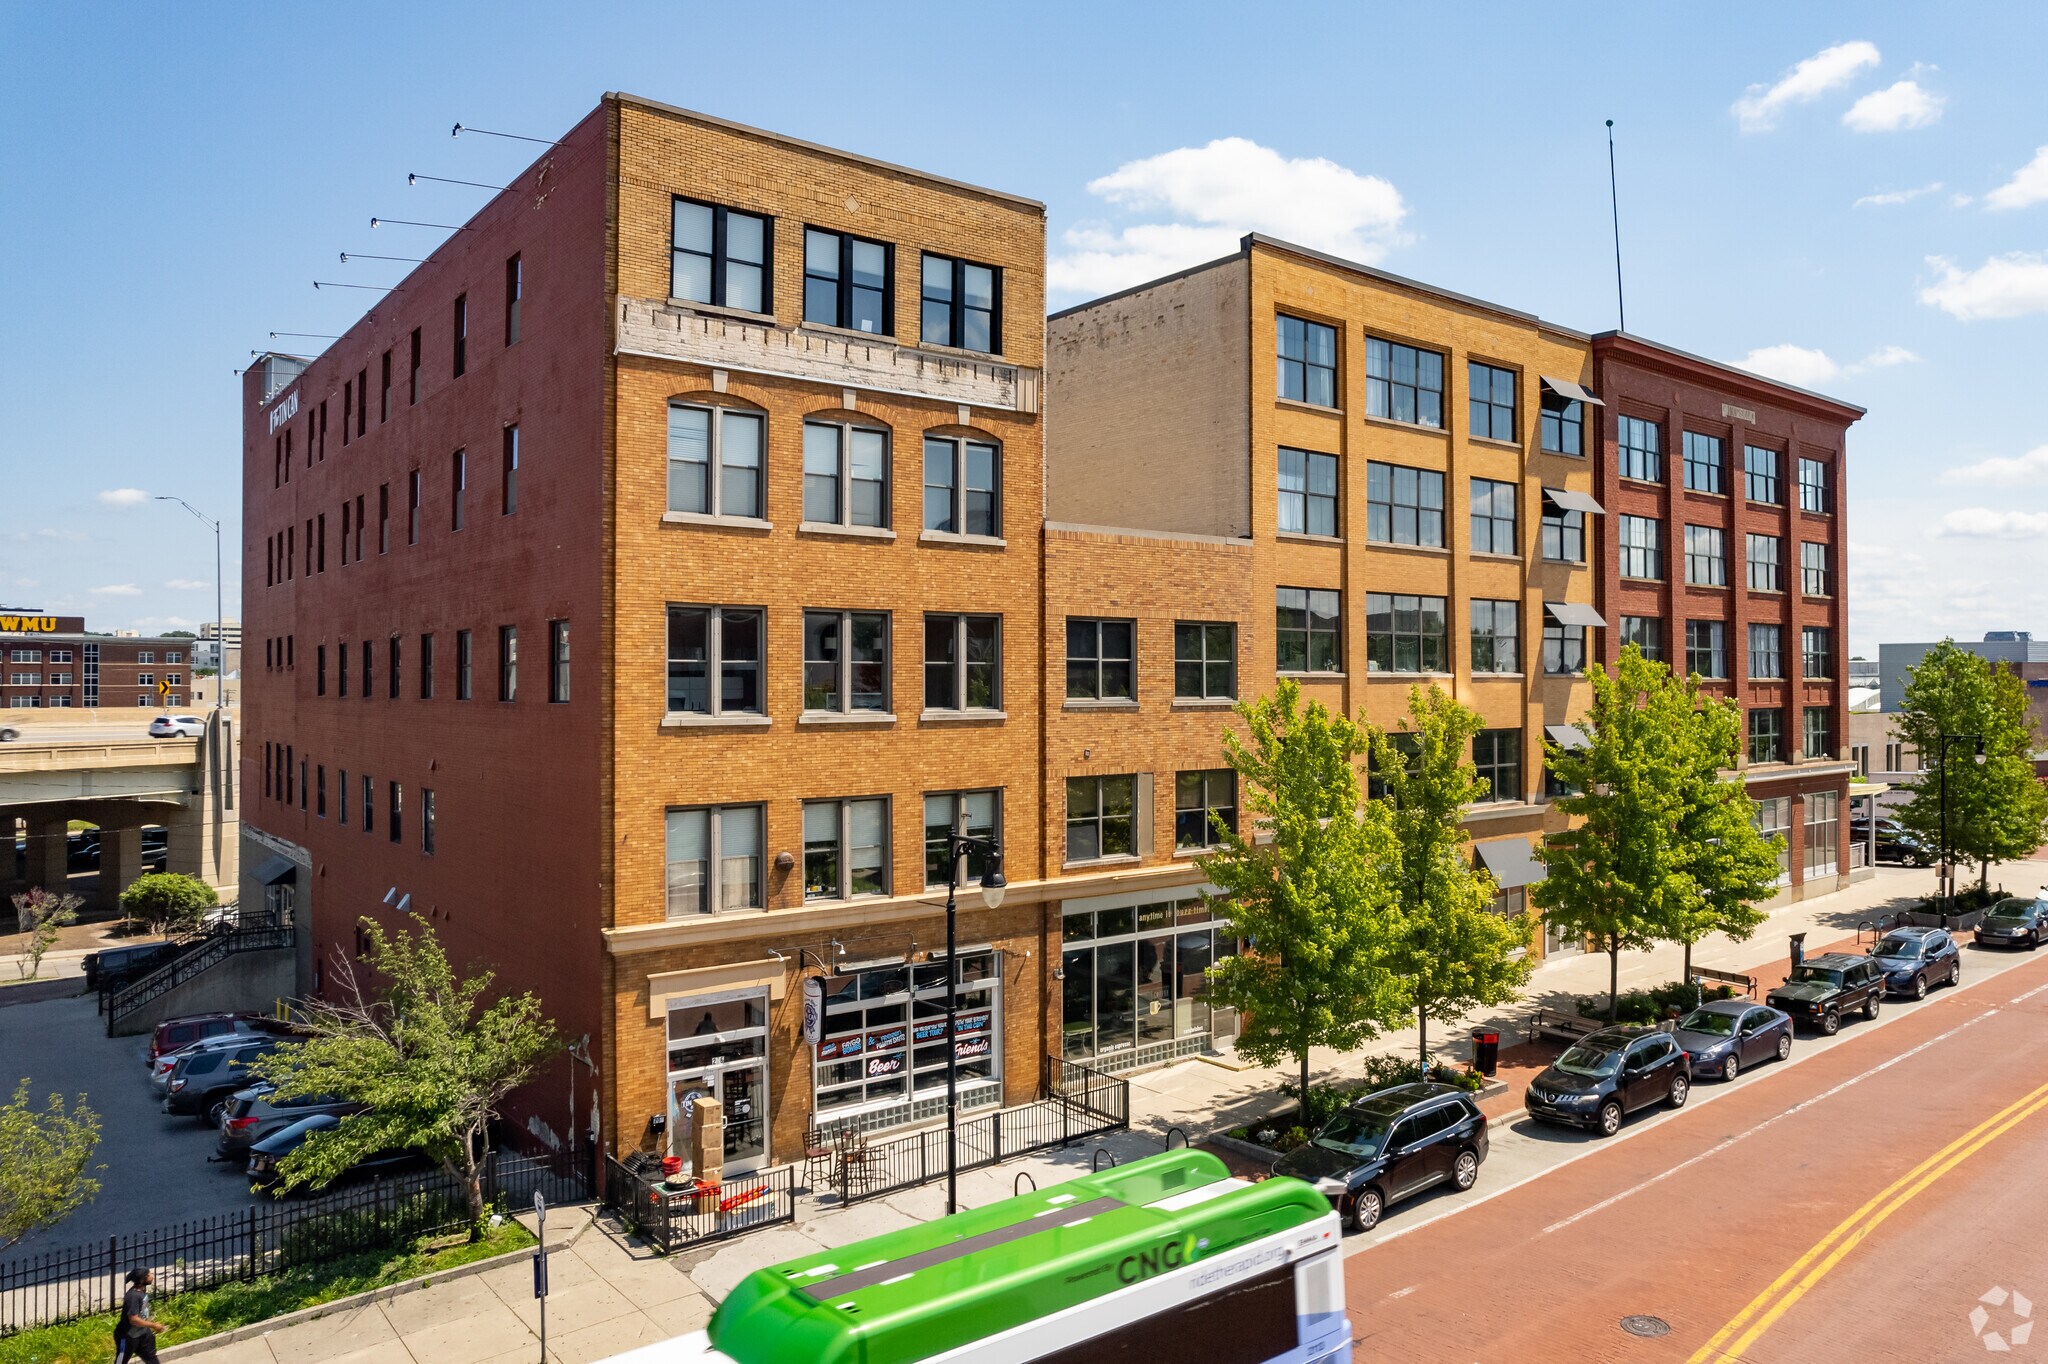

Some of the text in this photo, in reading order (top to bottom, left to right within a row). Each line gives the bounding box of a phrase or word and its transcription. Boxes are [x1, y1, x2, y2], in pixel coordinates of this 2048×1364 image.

[0, 616, 57, 632] WMU
[1138, 911, 1163, 922] anytime
[841, 1037, 861, 1049] FAYGO
[868, 1036, 875, 1046] &
[955, 1039, 989, 1056] Friends
[868, 1058, 900, 1074] Beer
[1116, 1241, 1183, 1285] CNG
